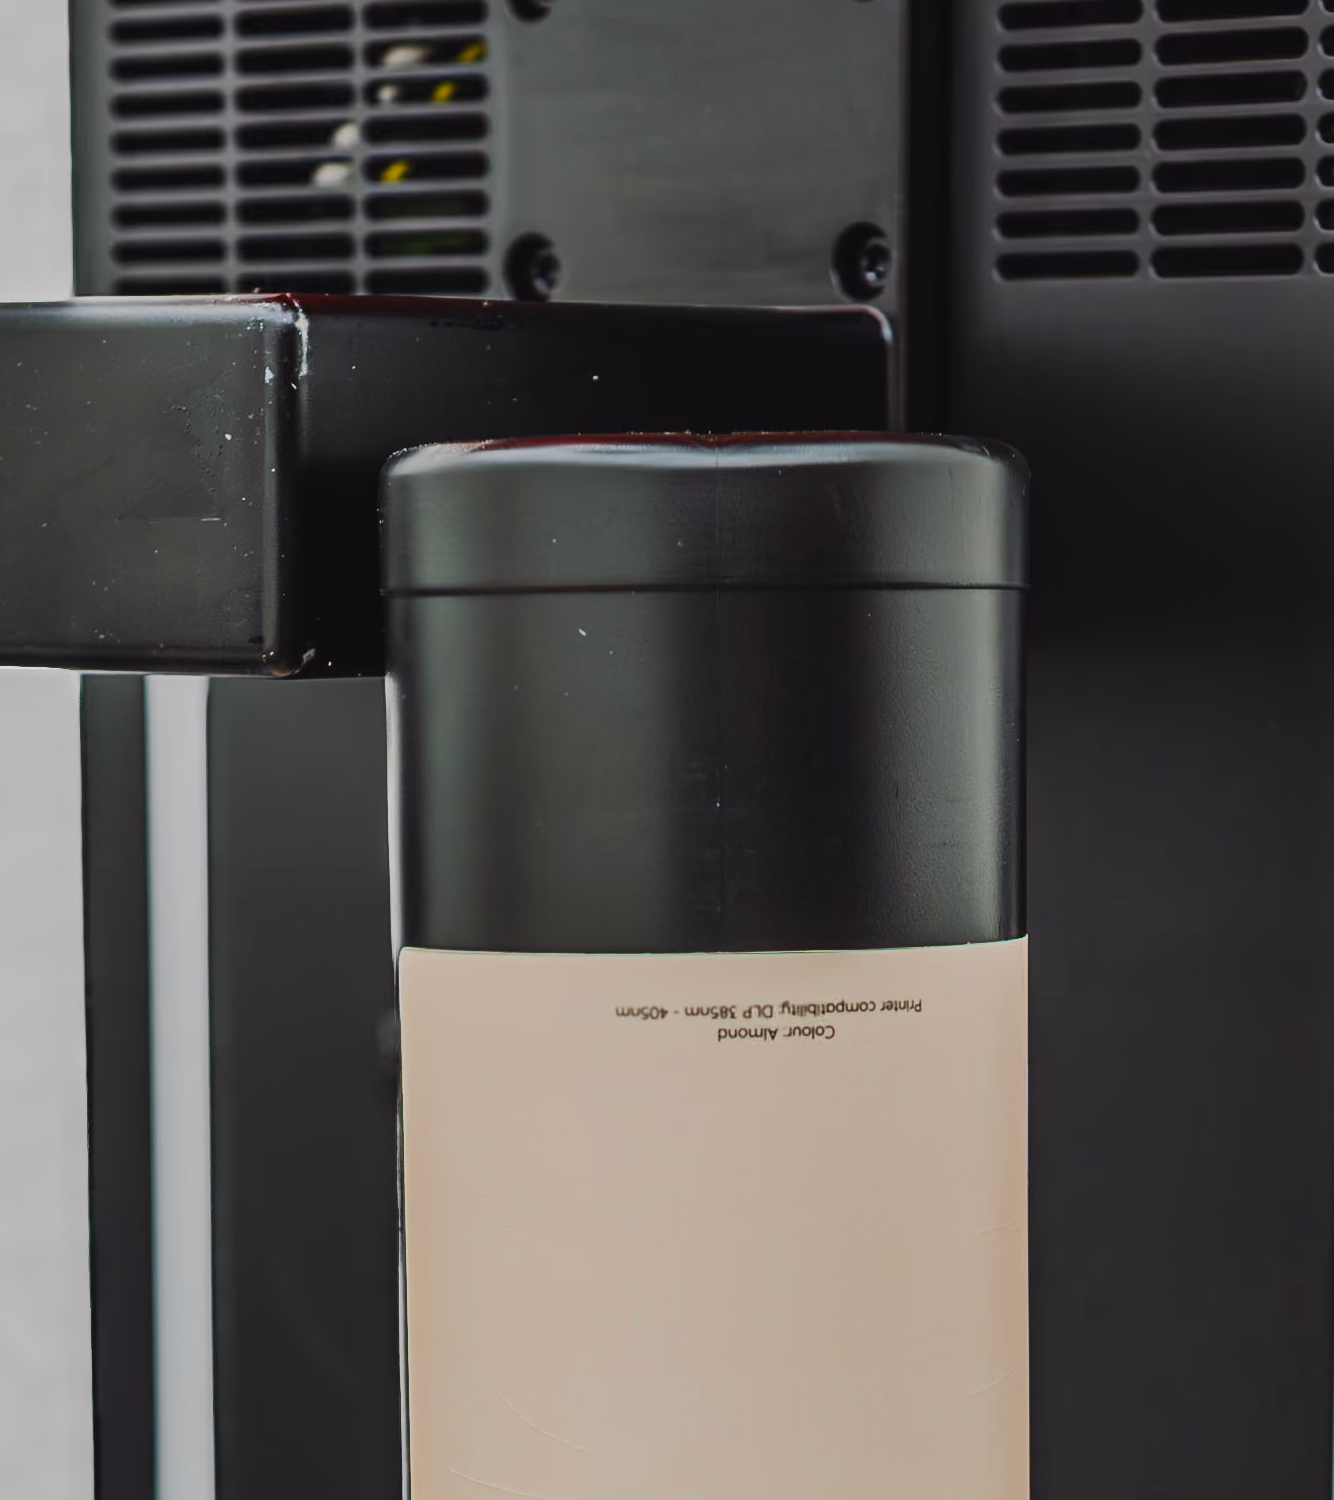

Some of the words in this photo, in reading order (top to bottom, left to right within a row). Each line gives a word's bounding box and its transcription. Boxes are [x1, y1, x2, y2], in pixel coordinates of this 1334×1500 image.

[615, 1005, 669, 1021] 405nm
[684, 1004, 737, 1020] 385nm
[742, 1004, 774, 1019] DLP
[779, 999, 877, 1016] compatibility:
[879, 998, 923, 1013] Printer
[717, 1026, 779, 1042] Almond
[782, 1024, 836, 1040] Colour:
